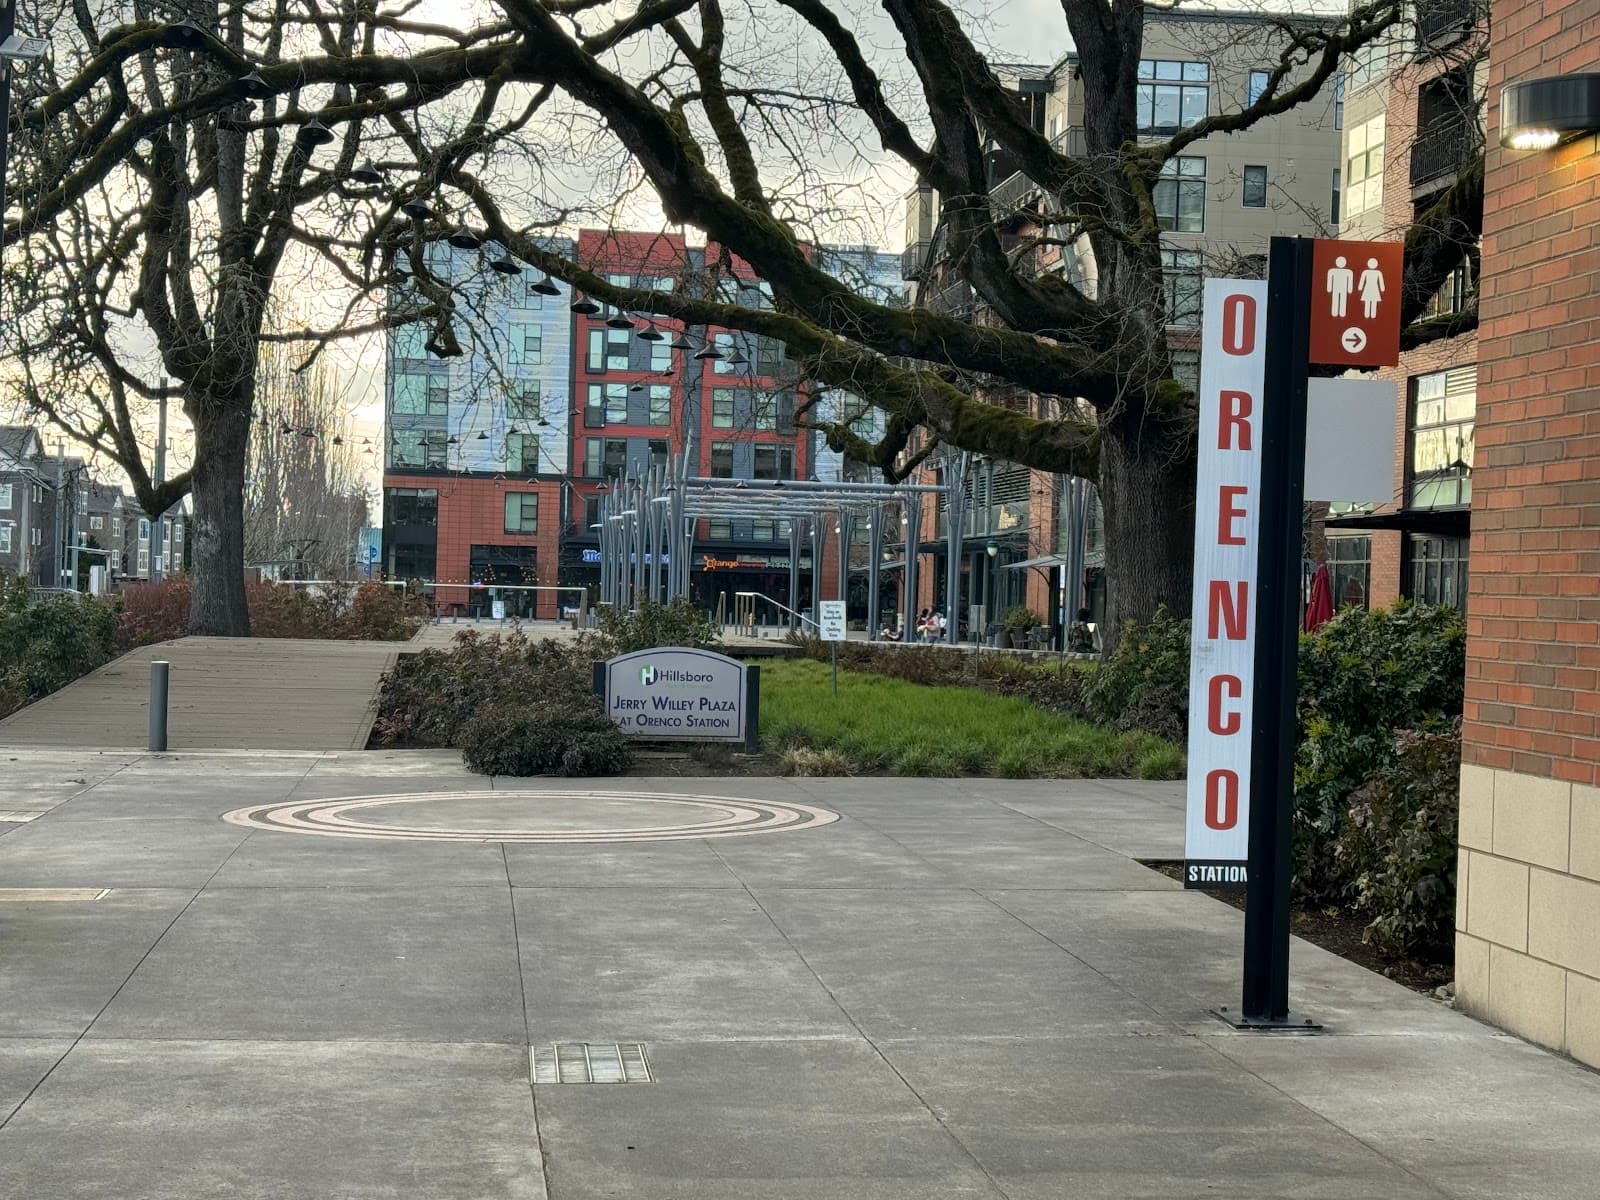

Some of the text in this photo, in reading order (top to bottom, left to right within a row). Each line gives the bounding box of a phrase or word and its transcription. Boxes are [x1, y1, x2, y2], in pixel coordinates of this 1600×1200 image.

[1204, 294, 1257, 831] ORENCO
[660, 670, 714, 683] Hillsboro
[613, 695, 736, 712] JERRY WILLEY PLAZA
[620, 713, 730, 728] AT ORENCO STATION
